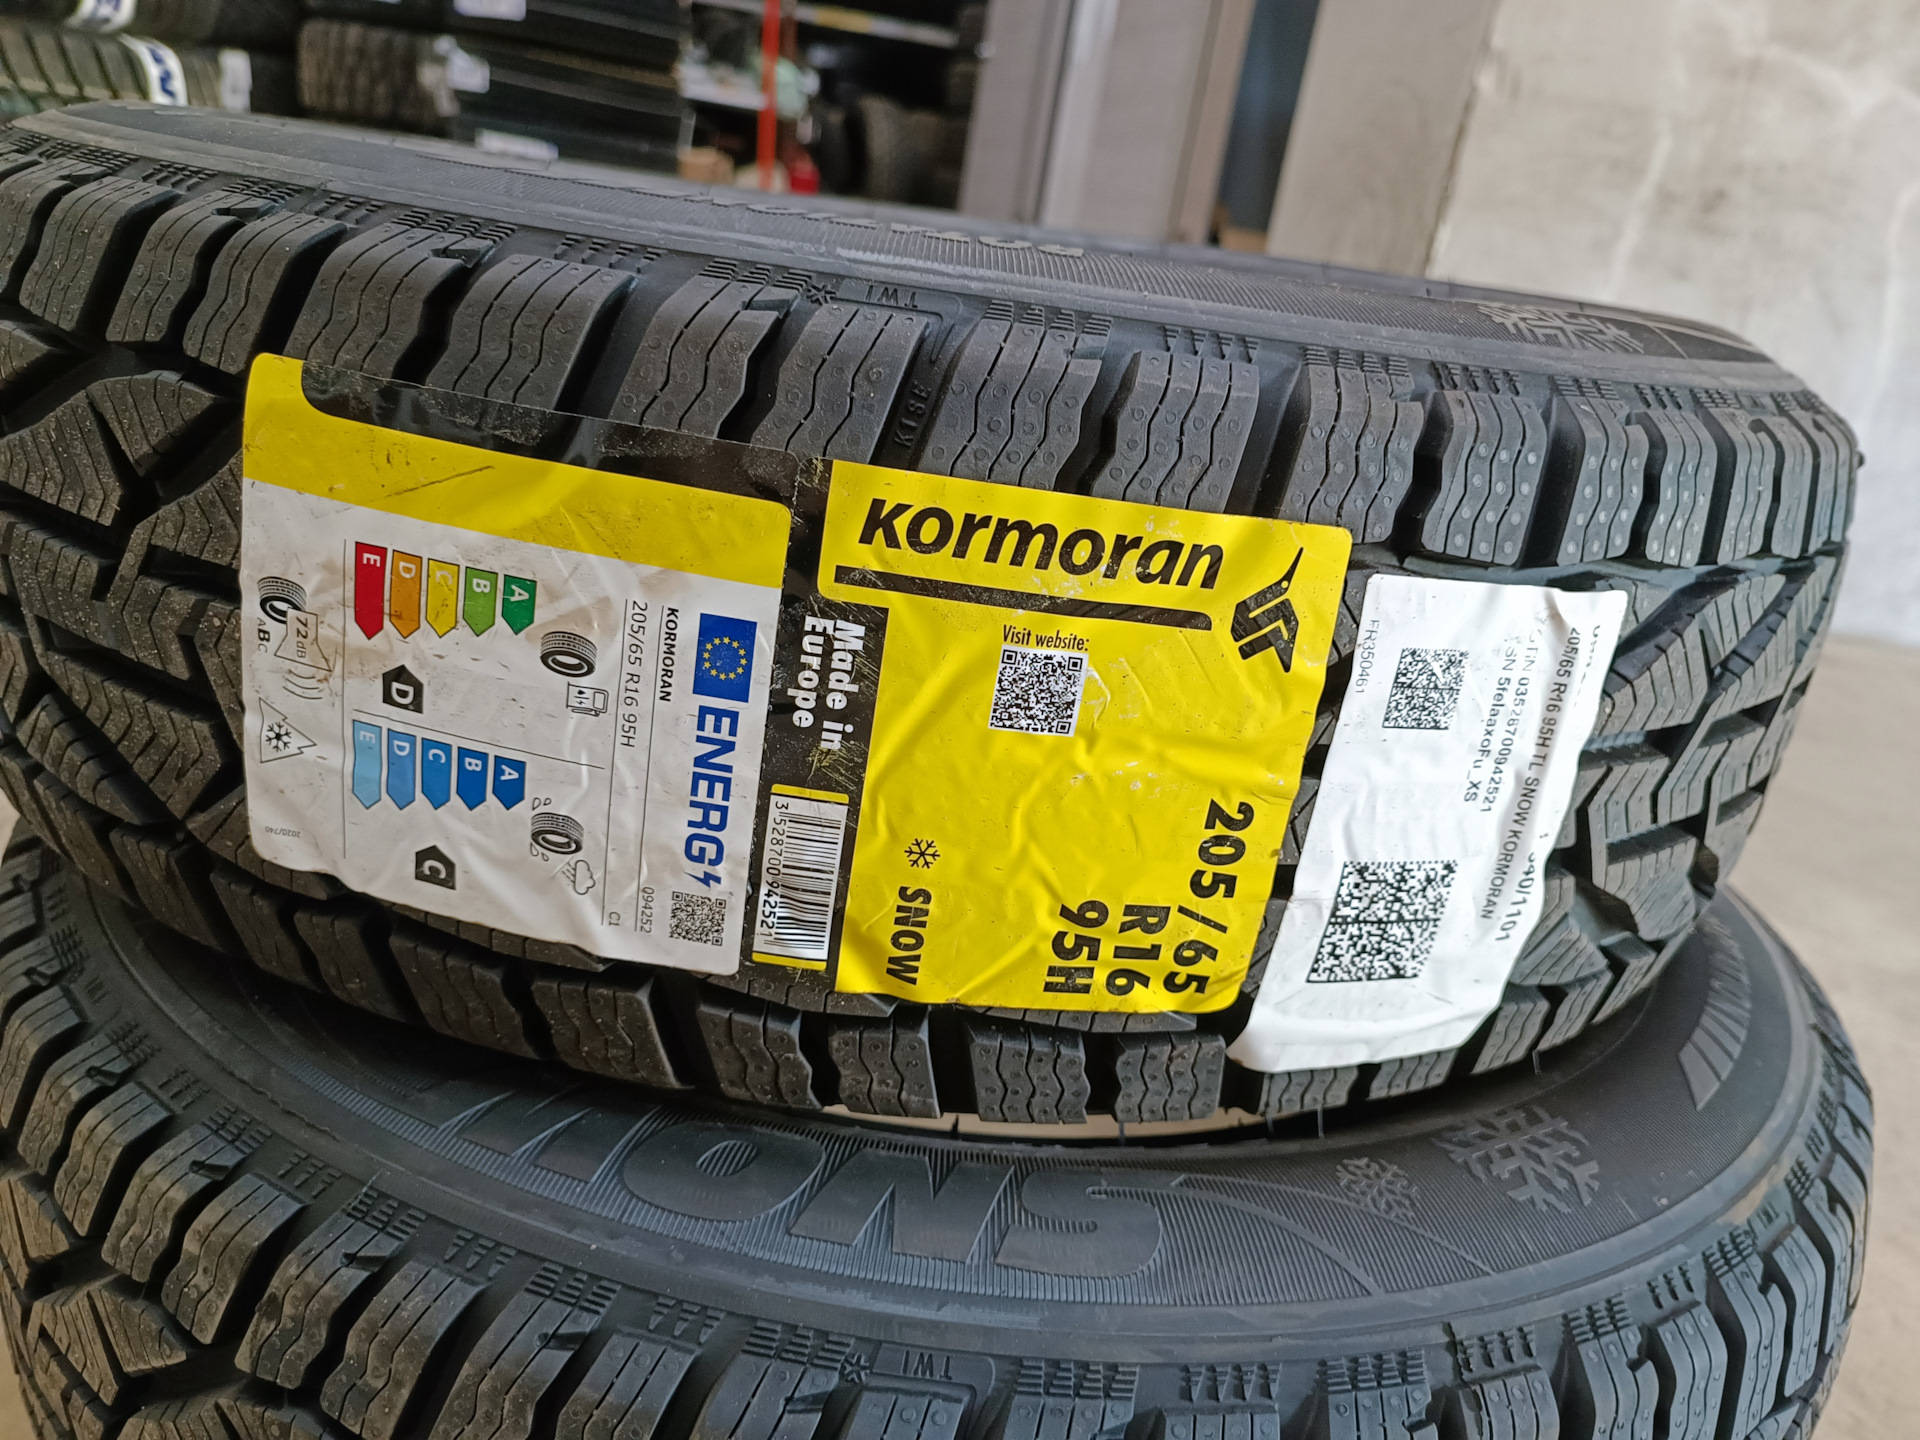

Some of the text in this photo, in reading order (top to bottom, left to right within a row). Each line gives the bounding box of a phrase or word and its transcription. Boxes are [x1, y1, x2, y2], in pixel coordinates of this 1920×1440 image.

[865, 284, 918, 309] TWI
[362, 553, 381, 567] E
[399, 561, 416, 579] D
[435, 570, 453, 585] C
[472, 578, 491, 594] B
[510, 584, 530, 602] A
[1002, 624, 1090, 652] Visit website:
[659, 607, 679, 702] KORMORAN
[620, 601, 648, 748] 205/65 R16 95H
[791, 615, 828, 729] Europe
[390, 681, 415, 705] D
[820, 619, 865, 751] Made in
[359, 730, 376, 744] E
[393, 740, 410, 757] D
[1480, 677, 1530, 812] 03528700942521
[428, 749, 446, 764] C
[464, 757, 483, 772] B
[500, 765, 520, 781] A
[1480, 627, 1581, 919] 205/65 R16 95H TL SNOW KORMORAN
[423, 860, 447, 879] C
[608, 911, 620, 926] C1
[640, 886, 655, 933] 094252
[886, 885, 932, 986] SNOW
[1042, 899, 1109, 995] 95H
[1105, 904, 1171, 996] R16
[899, 1351, 955, 1380] TWI
